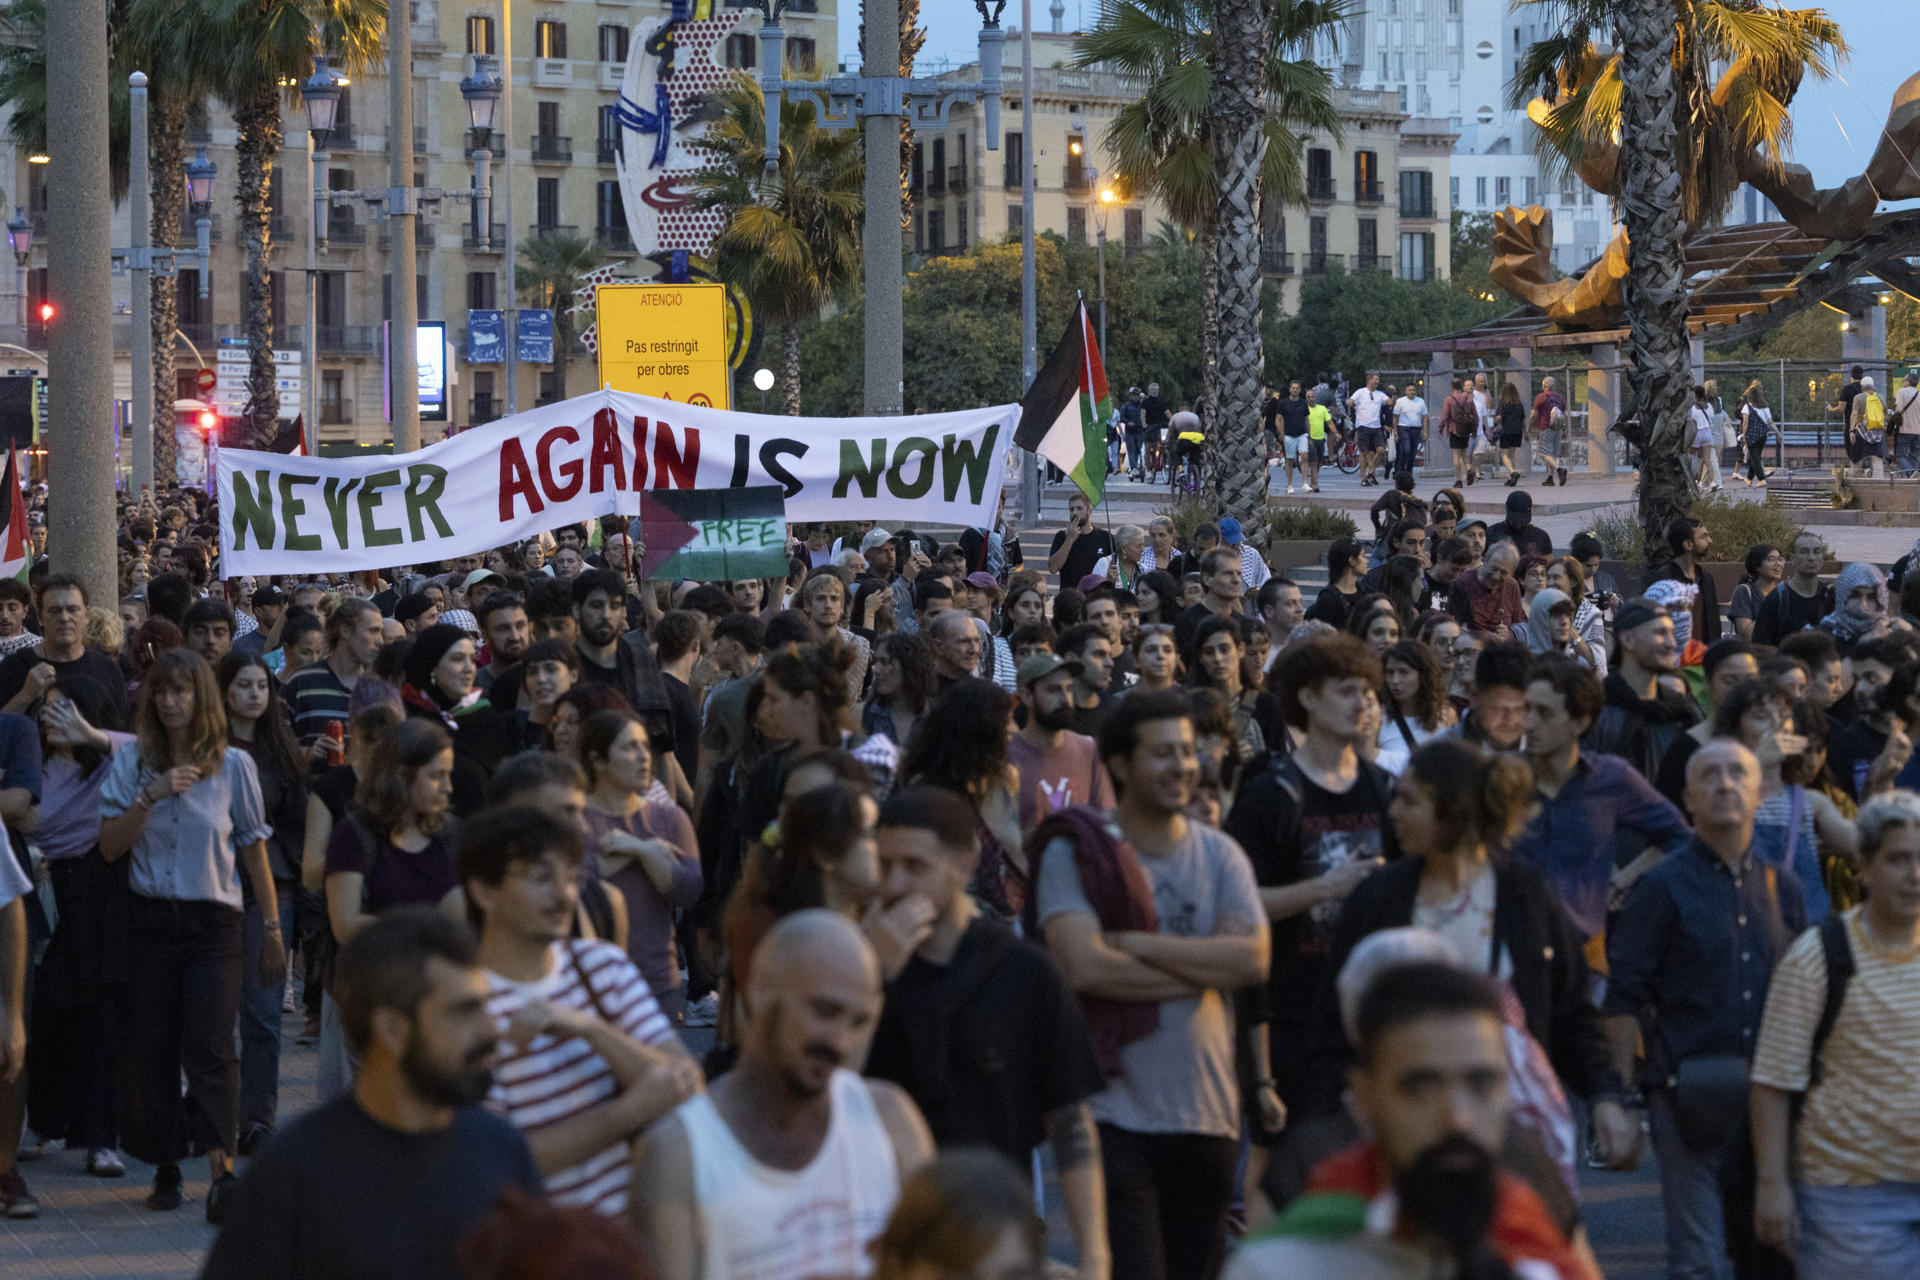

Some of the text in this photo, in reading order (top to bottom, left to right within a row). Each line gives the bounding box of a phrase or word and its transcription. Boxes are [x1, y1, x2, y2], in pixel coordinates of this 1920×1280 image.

[640, 291, 683, 306] ATENCIÓ
[626, 338, 699, 356] Pas restringit
[637, 362, 690, 380] per obres
[232, 407, 1000, 551] NEVER AGAIN IS NOW
[701, 518, 785, 547] FREE
